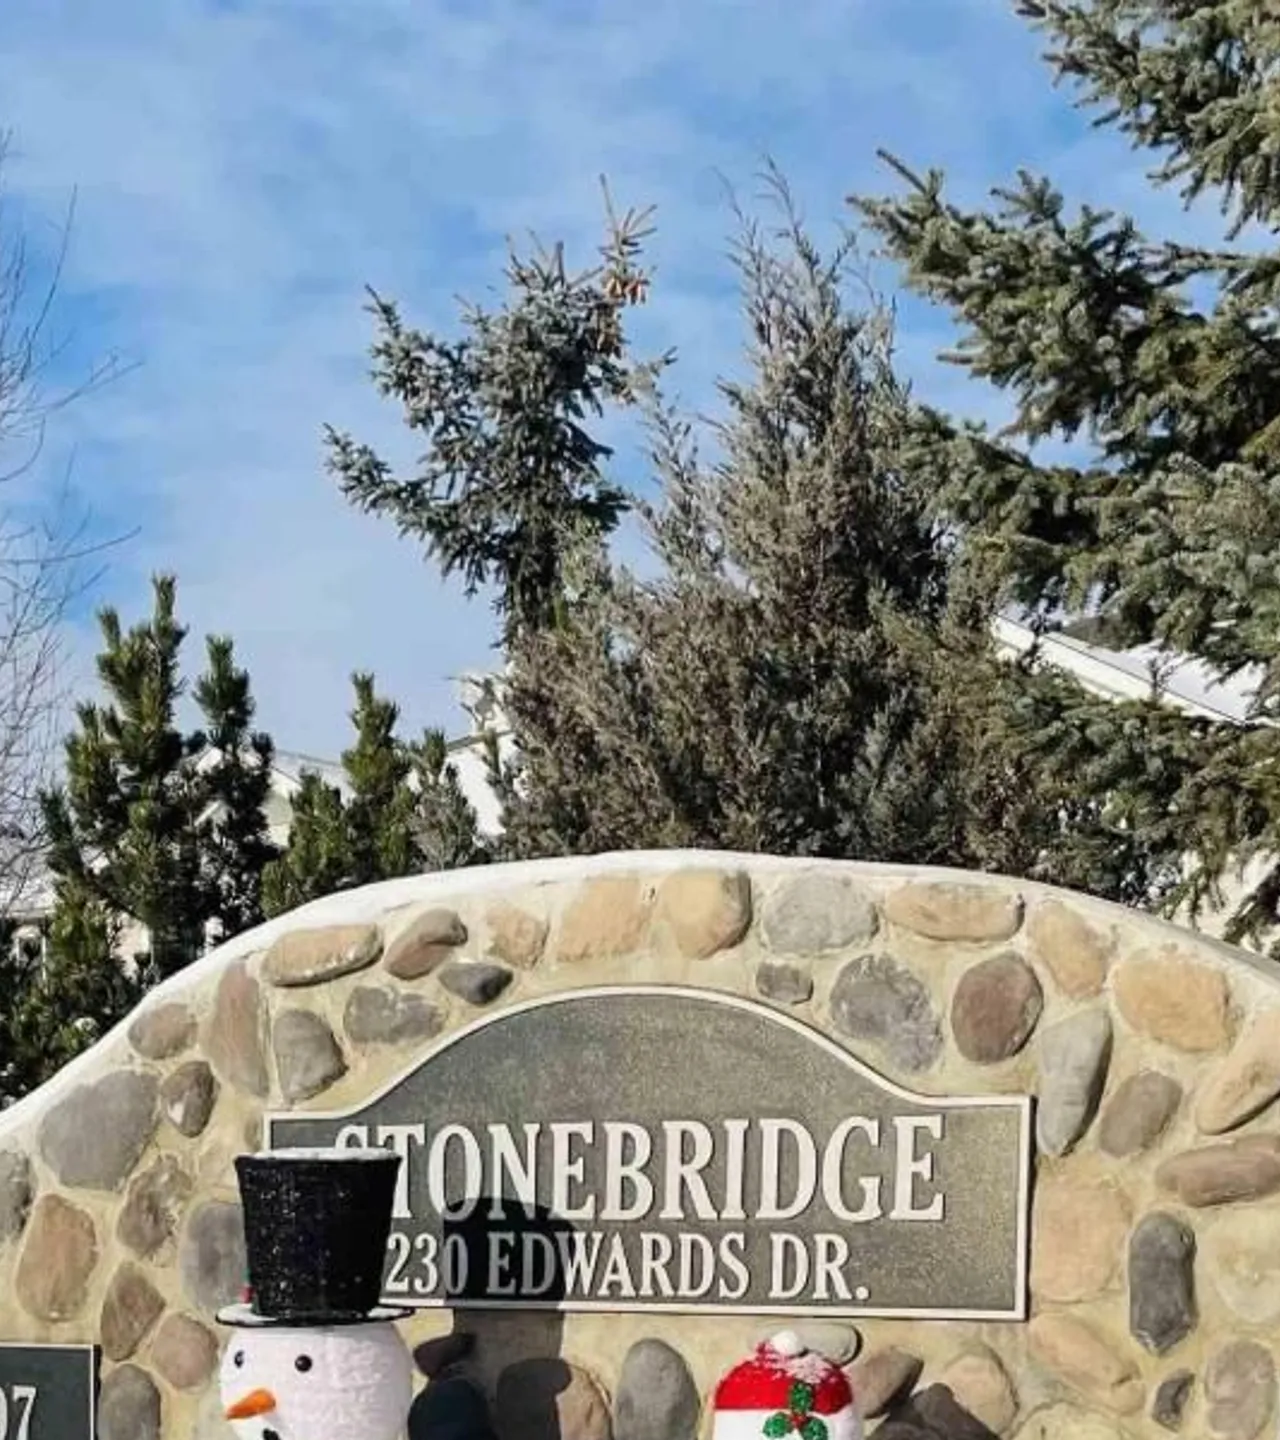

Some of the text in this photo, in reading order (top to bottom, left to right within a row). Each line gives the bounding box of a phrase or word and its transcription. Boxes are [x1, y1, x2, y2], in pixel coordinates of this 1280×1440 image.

[334, 1114, 946, 1222] TONEBRIDGE
[384, 1231, 872, 1303] 230 EDWARDS DR.
